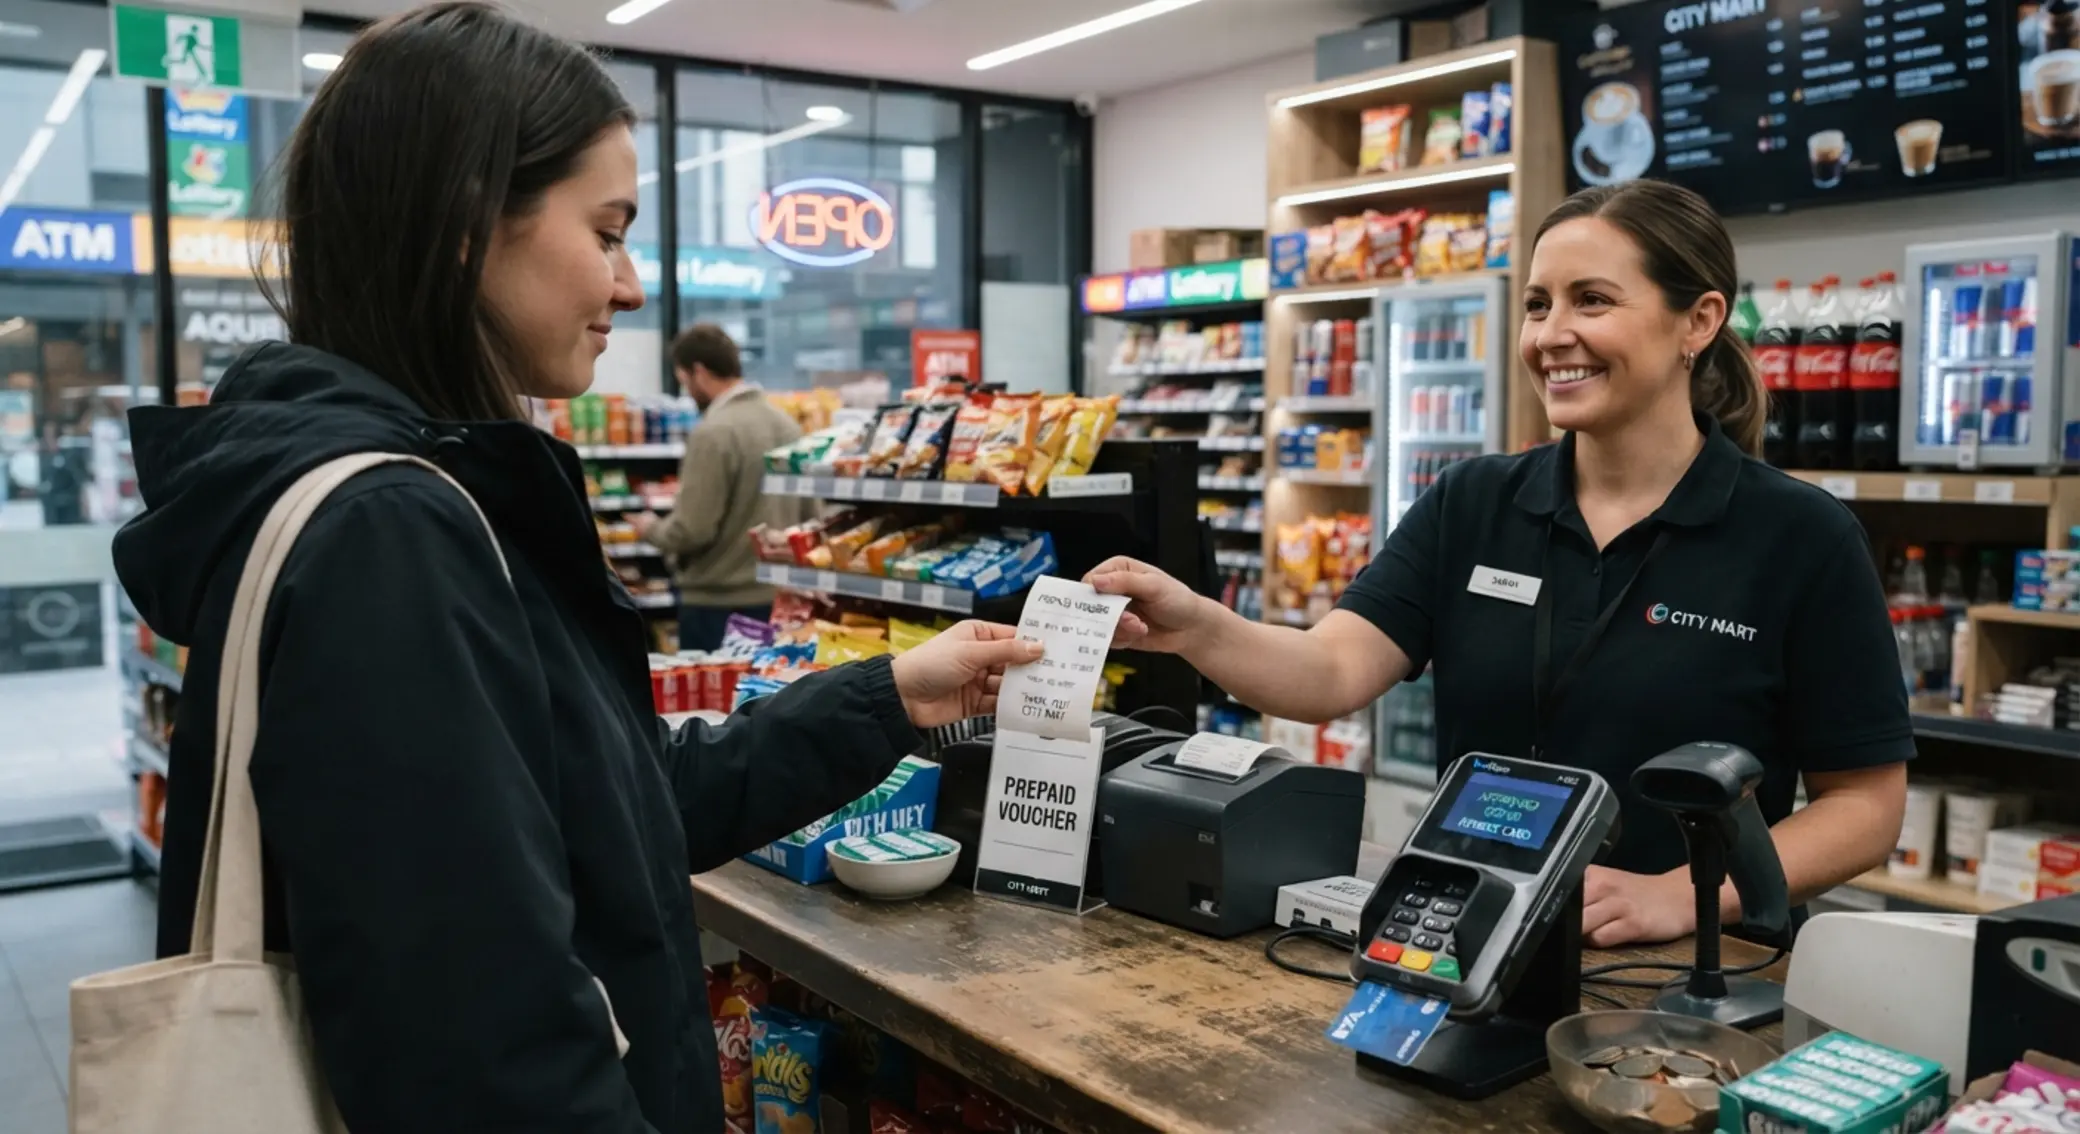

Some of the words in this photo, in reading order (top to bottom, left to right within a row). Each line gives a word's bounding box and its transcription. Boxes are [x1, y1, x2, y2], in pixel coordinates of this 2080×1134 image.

[12, 219, 116, 262] ATM
[1671, 610, 1708, 629] CITY
[1004, 776, 1077, 805] PREPAID
[999, 800, 1077, 832] VOUCHER
